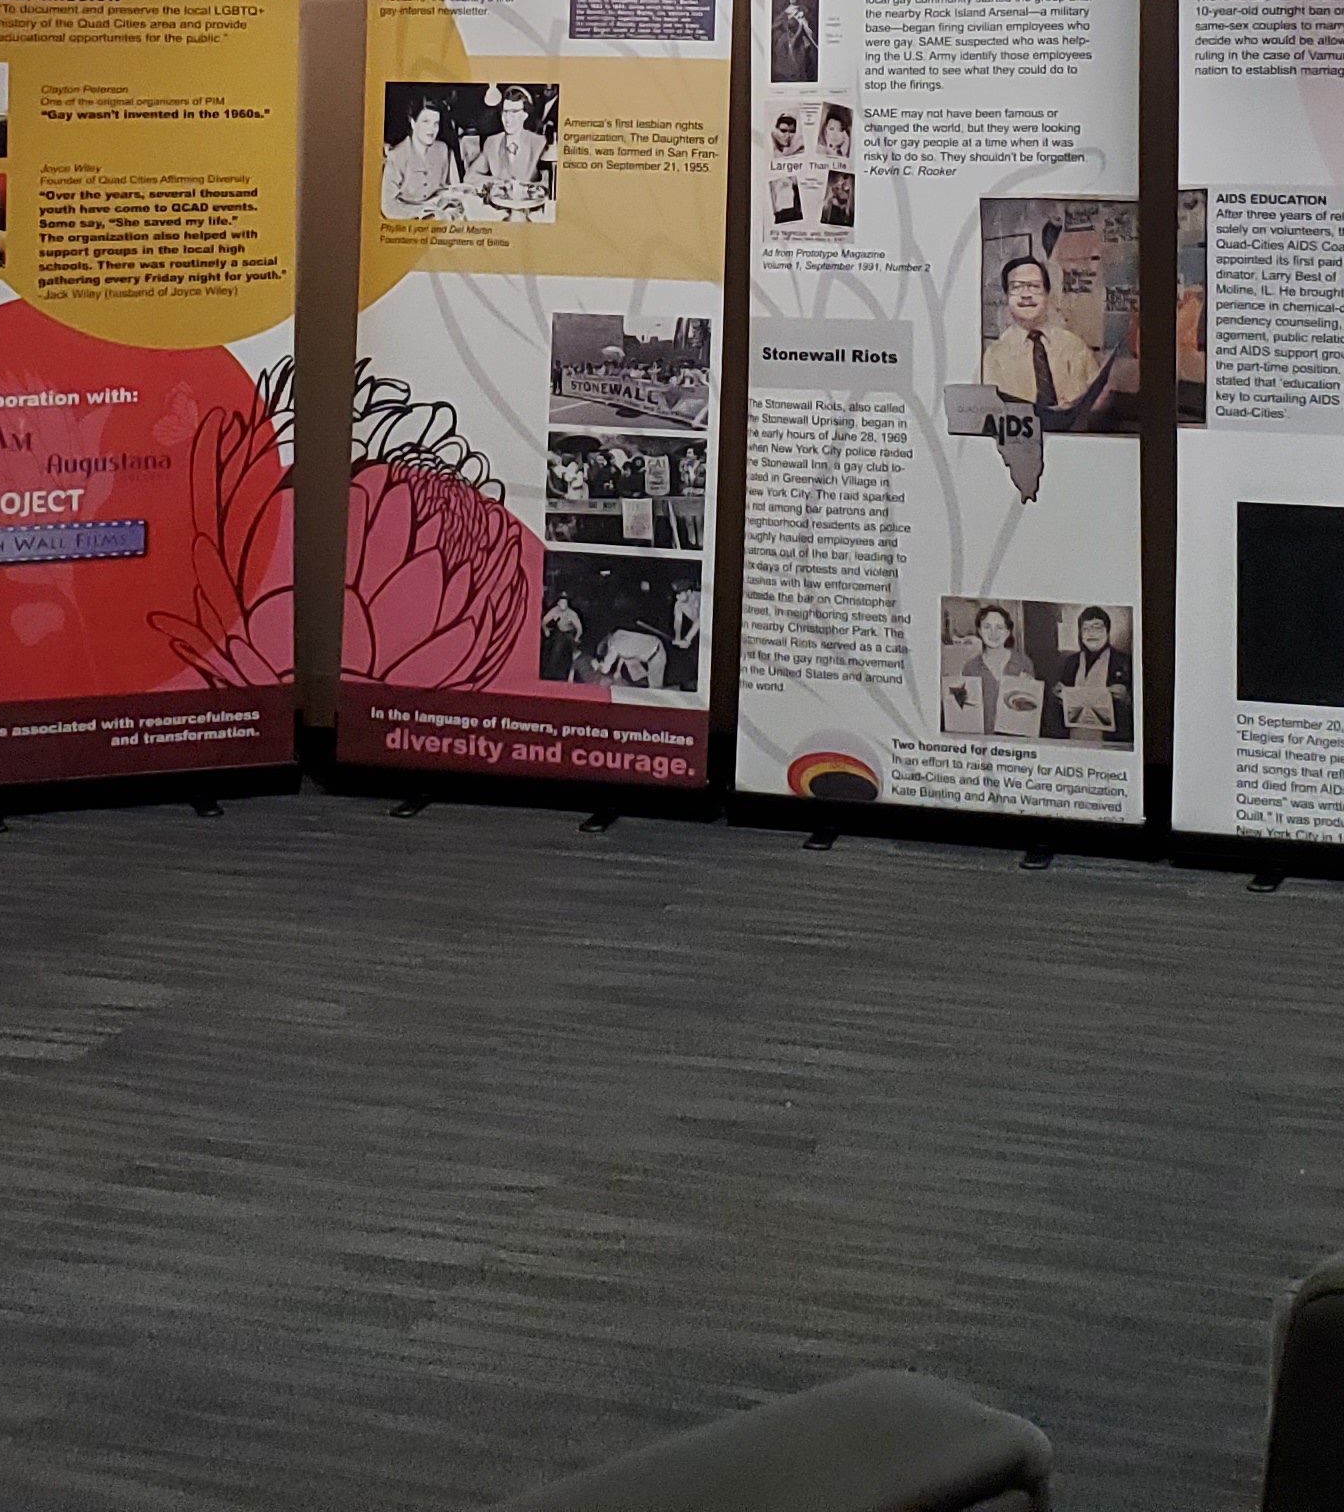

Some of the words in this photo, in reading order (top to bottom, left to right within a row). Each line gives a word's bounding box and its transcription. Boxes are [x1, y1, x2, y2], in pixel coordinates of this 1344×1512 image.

[19, 4, 79, 14] document
[80, 4, 104, 14] and
[106, 6, 159, 16] preserve
[161, 5, 180, 14] the
[183, 5, 211, 15] local
[39, 17, 52, 28] of
[54, 18, 73, 28] the
[76, 17, 110, 28] Quad
[112, 18, 147, 28] Cities
[149, 21, 176, 29] area
[178, 19, 201, 29] and
[204, 19, 247, 31] provide
[123, 109, 179, 119] invented
[183, 109, 194, 119] in
[198, 109, 219, 118] the
[614, 118, 633, 128] first
[635, 119, 672, 129] lesbian
[674, 120, 704, 132] rights
[770, 161, 803, 172] Larger
[79, 190, 101, 200] the
[148, 188, 196, 198] several
[199, 187, 258, 197] thousand
[1215, 193, 1246, 203] AIDS
[1249, 193, 1326, 205] EDUCATION
[1215, 208, 1243, 219] After
[1245, 209, 1276, 220] three
[1279, 212, 1312, 223] years
[1314, 210, 1327, 221] of
[762, 346, 845, 362] Stonewall
[851, 349, 897, 364] Riots
[86, 386, 138, 404] with:
[571, 381, 659, 405] STONEWALL
[982, 413, 1034, 446] AIDS
[46, 453, 172, 479] Augustana
[11, 719, 96, 736] associated
[100, 716, 134, 729] with
[138, 708, 260, 727] resourcefulness
[370, 706, 384, 719] In
[387, 707, 410, 721] the
[414, 710, 478, 729] language
[482, 715, 497, 728] of
[500, 717, 557, 736] flowers,
[561, 723, 608, 740] protea
[612, 726, 693, 748] symbolizes
[1236, 713, 1254, 725] On
[1257, 714, 1323, 731] September
[110, 732, 138, 746] and
[143, 726, 259, 743] transformation.
[385, 726, 503, 764] diversity
[511, 737, 561, 763] and
[571, 747, 695, 781] courage.
[891, 737, 915, 750] Two
[917, 740, 967, 754] honored
[970, 743, 988, 756] for
[989, 746, 1037, 761] designs
